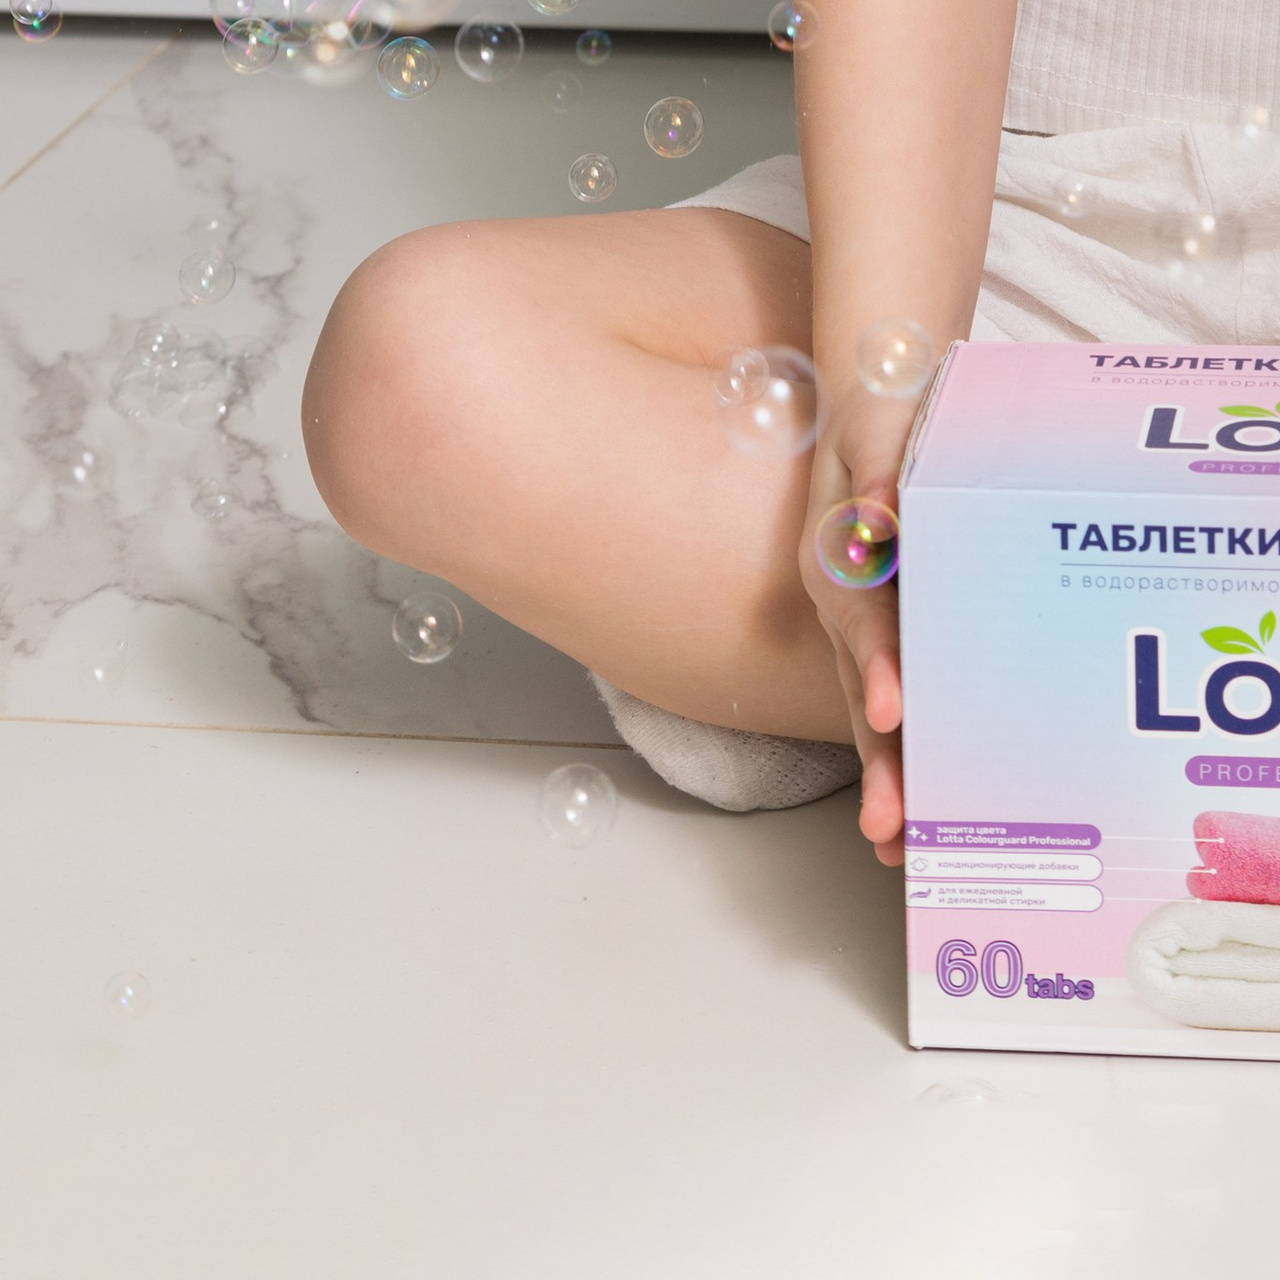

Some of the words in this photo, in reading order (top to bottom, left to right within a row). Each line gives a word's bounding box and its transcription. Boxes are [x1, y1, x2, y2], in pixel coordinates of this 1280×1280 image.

[1060, 575, 1071, 588] в
[936, 826, 974, 836] защита
[976, 827, 1007, 835] цвета
[936, 835, 964, 844] Lotta
[965, 835, 1027, 846] Colourguard
[1029, 836, 1091, 846] Professional
[937, 862, 1036, 871] кондиционирующие
[1038, 863, 1080, 871] добавки
[959, 887, 1022, 896] ежедневной
[947, 897, 1007, 905] деликатной
[1009, 898, 1046, 907] стирки
[936, 939, 1023, 998] 60
[1025, 973, 1095, 1000] tabs
